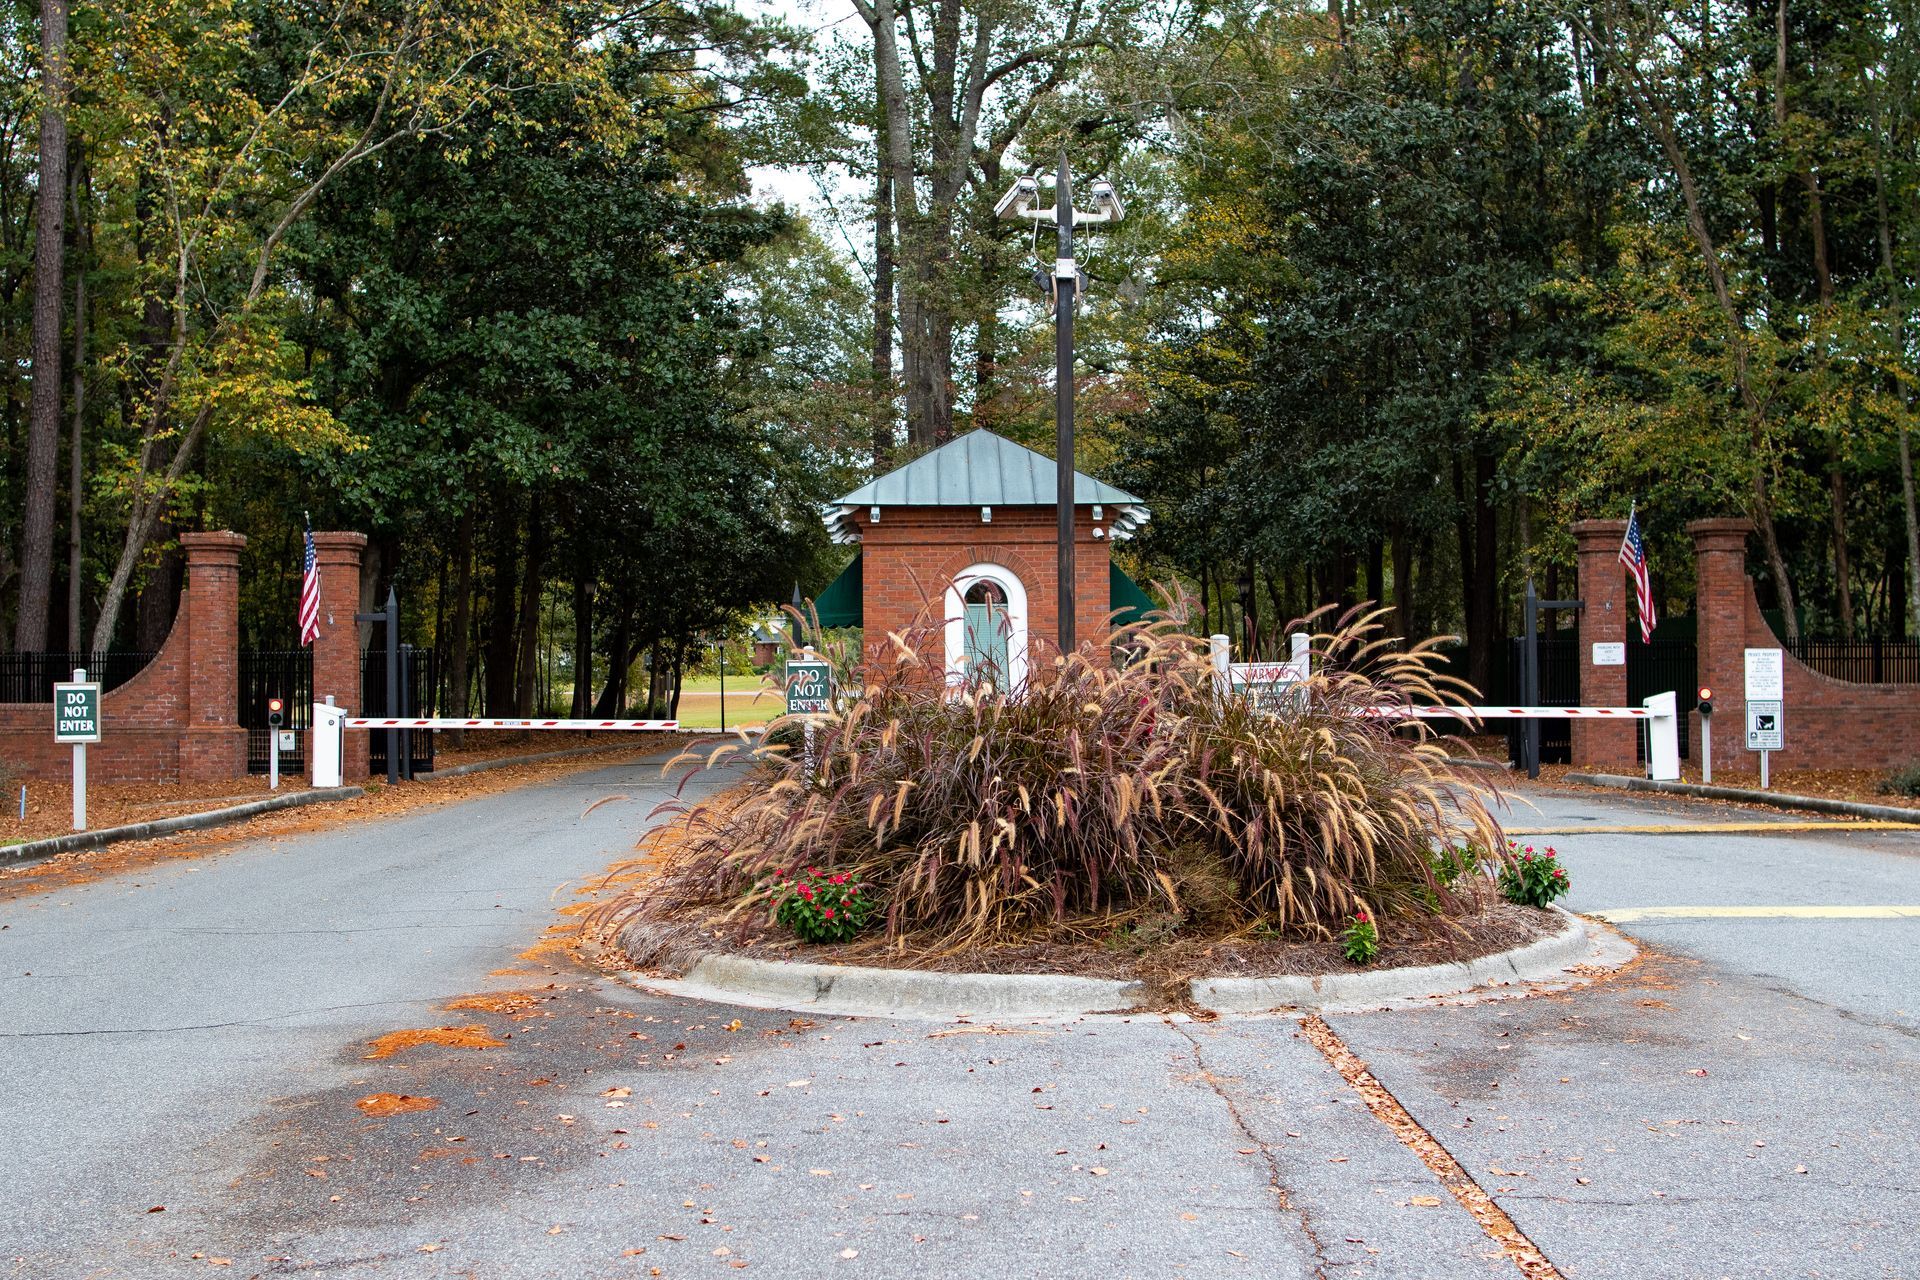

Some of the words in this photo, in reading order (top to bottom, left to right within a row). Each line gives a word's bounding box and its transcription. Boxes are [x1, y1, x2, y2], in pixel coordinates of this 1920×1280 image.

[798, 670, 819, 682] DO
[1244, 667, 1289, 680] WARNING
[794, 685, 823, 696] NOT
[67, 693, 86, 704] DO
[64, 706, 88, 717] NOT
[60, 720, 94, 731] ENTER
